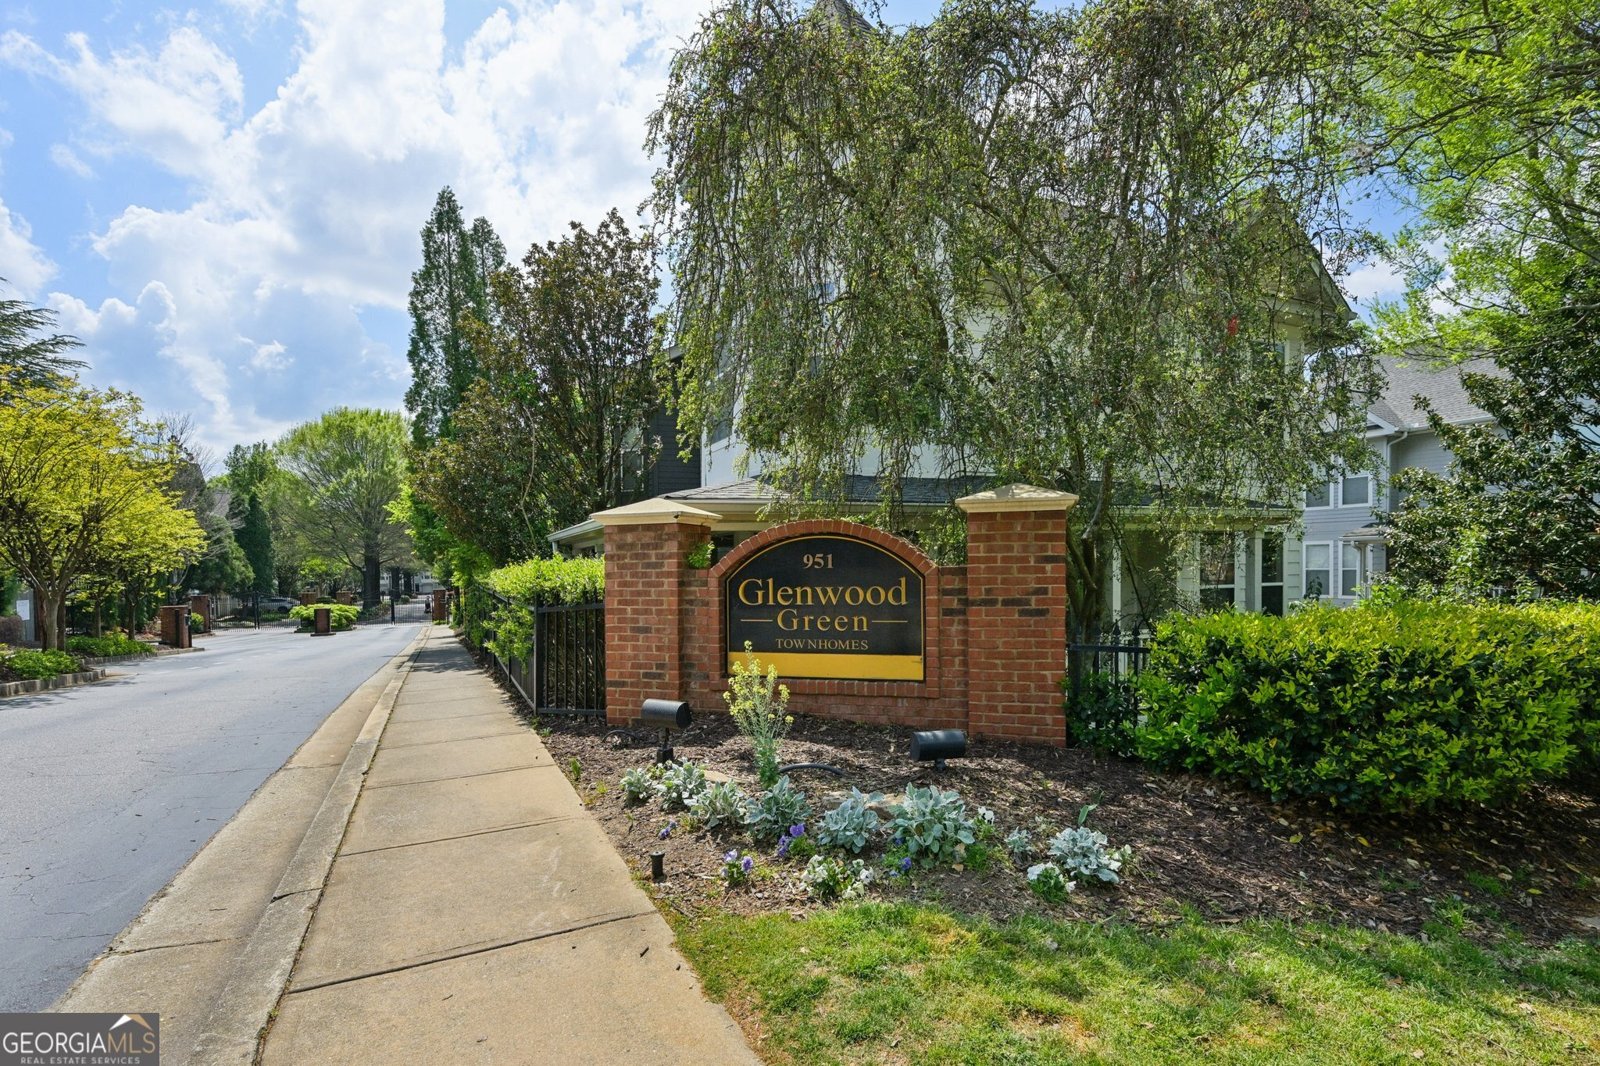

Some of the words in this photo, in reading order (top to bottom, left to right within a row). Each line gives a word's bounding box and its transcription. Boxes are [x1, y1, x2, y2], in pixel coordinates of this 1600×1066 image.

[802, 553, 834, 569] 951
[738, 577, 908, 606] Glenwood
[777, 608, 869, 632] Green
[775, 639, 869, 650] TOWNHOMES
